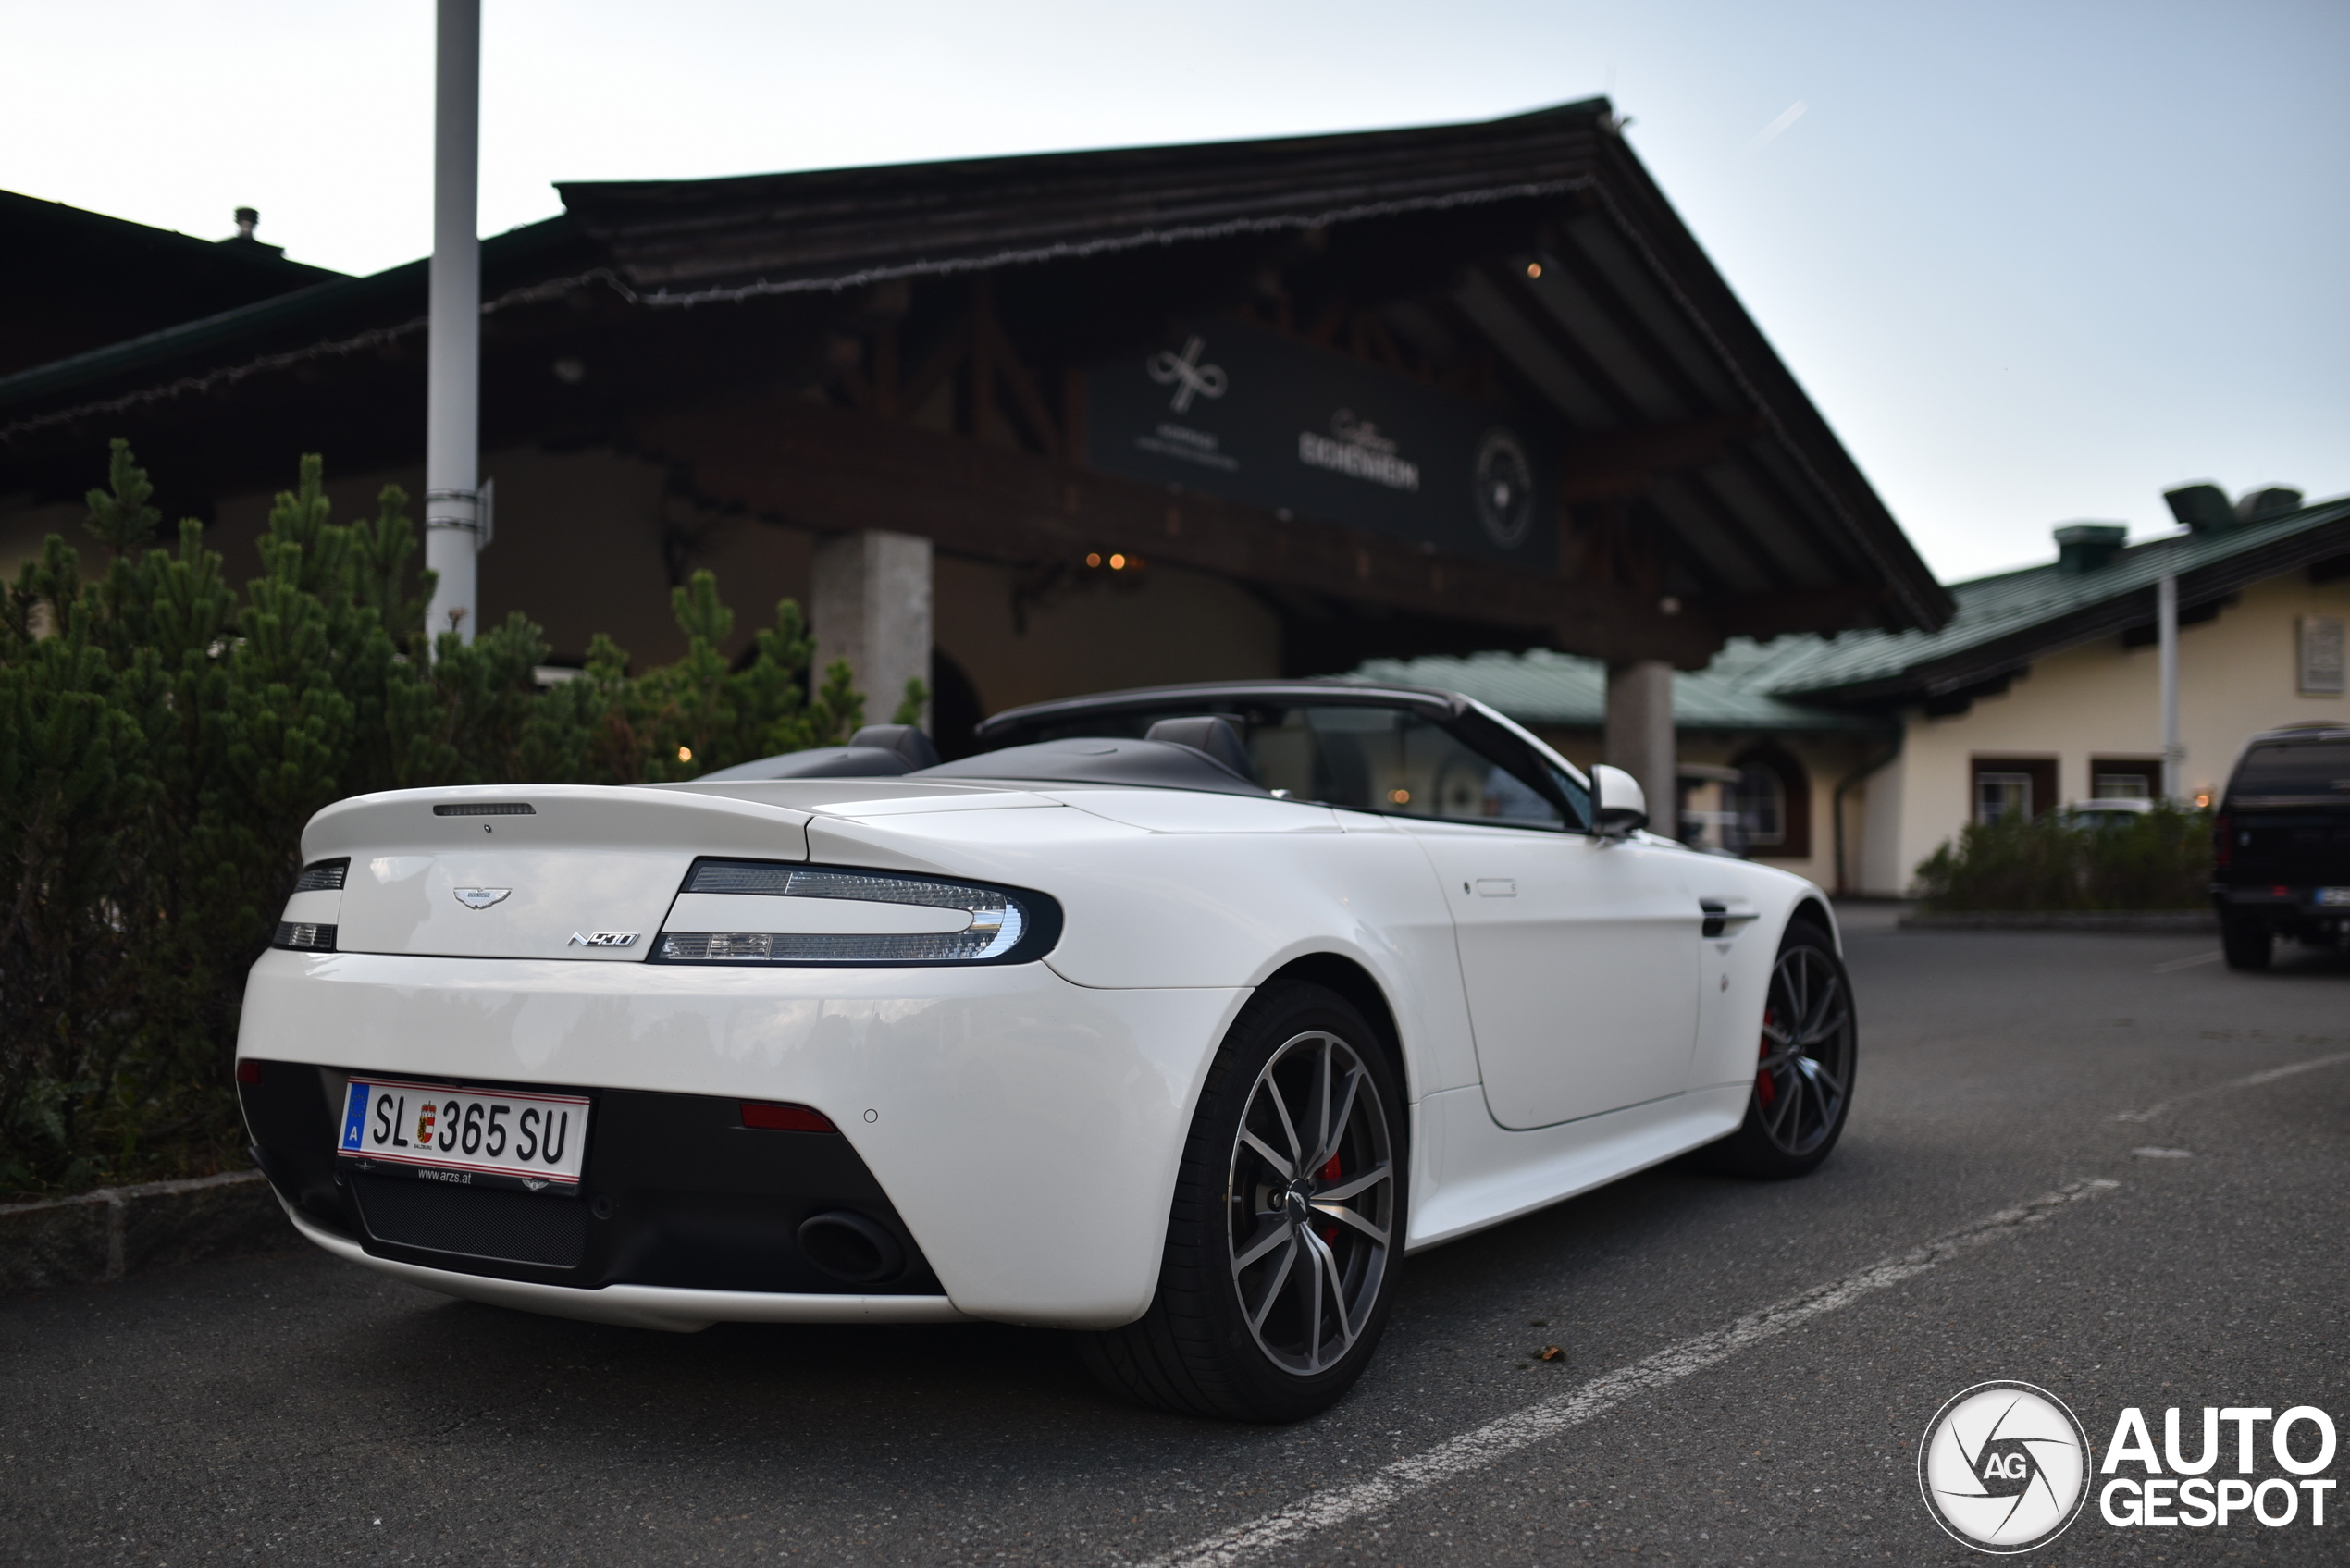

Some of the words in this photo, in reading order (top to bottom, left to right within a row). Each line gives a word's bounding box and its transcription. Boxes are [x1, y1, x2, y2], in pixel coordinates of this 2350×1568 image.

[566, 932, 640, 947] N430
[349, 1126, 358, 1142] A
[373, 1093, 408, 1147] SL
[439, 1100, 511, 1157] 365
[516, 1107, 568, 1164] SU
[418, 1168, 472, 1185] www.arzs.at
